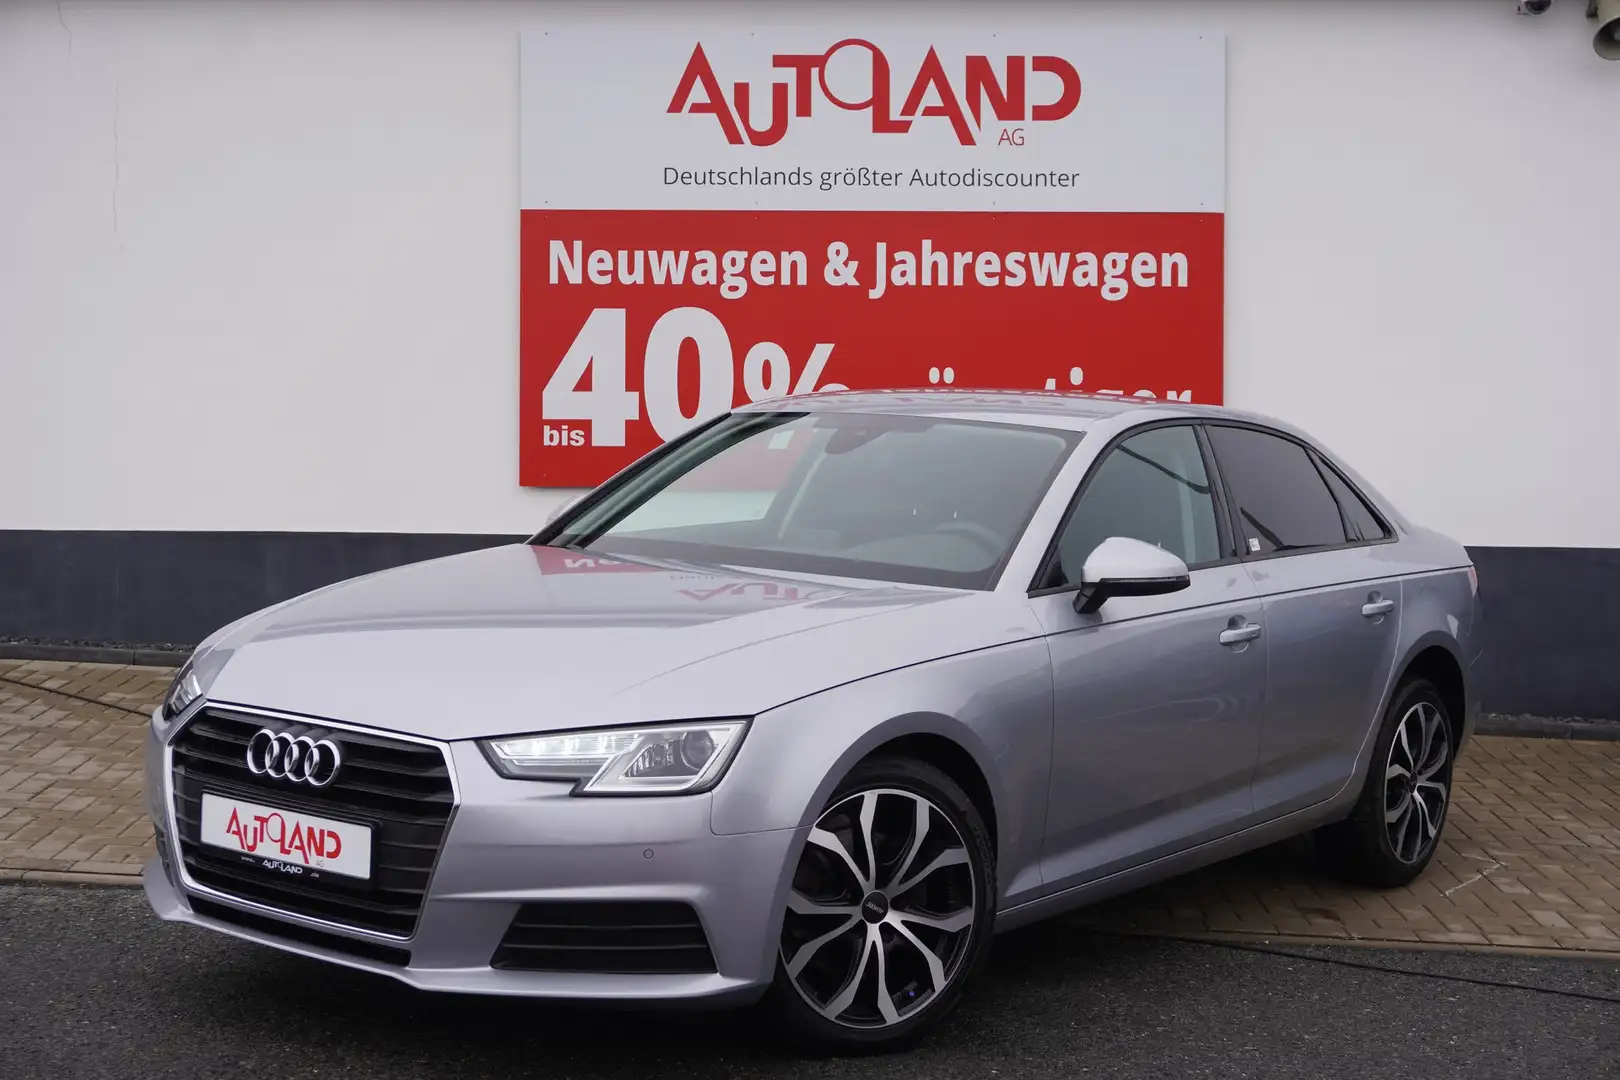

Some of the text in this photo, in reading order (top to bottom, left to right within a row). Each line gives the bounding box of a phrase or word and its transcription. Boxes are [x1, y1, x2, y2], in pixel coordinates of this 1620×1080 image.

[667, 38, 1082, 147] AUTOLAND
[998, 128, 1025, 146] AG
[664, 166, 1081, 192] Deutschlands größter Autodiscounter
[549, 239, 1188, 302] Neuwagen & Jahreswagen
[542, 424, 585, 447] bis
[226, 806, 342, 864] AUTOLAND
[262, 859, 303, 874] AUTOLAND
